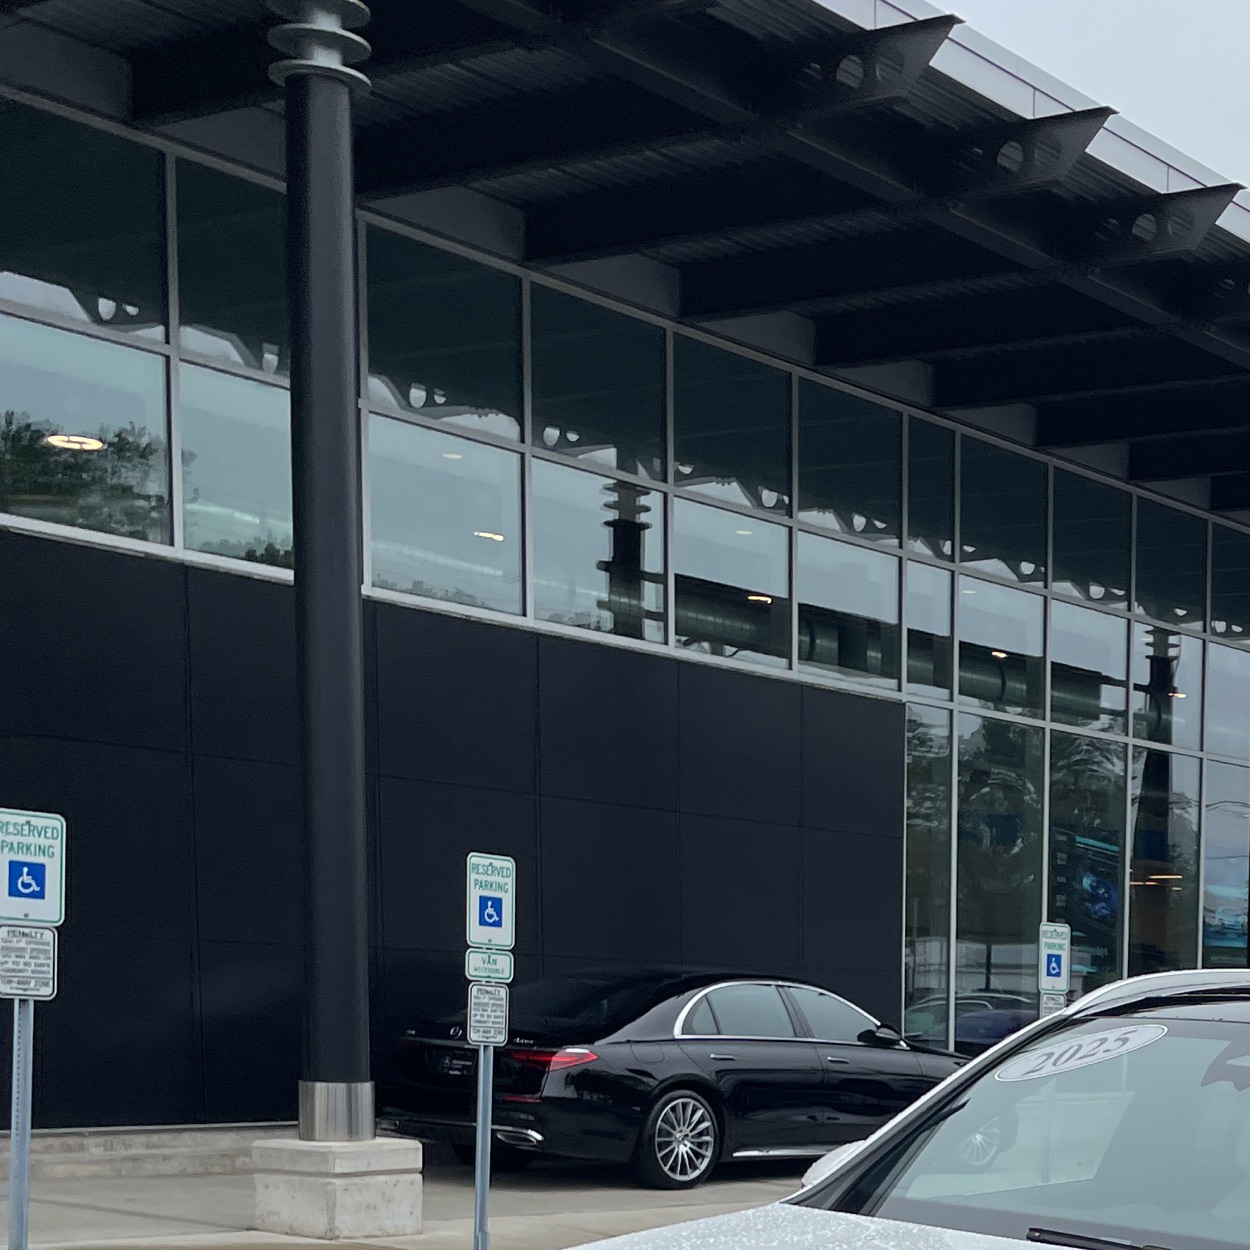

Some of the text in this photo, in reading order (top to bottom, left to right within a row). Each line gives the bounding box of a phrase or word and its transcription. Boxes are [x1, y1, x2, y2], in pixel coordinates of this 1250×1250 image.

[0, 820, 60, 840] RESERVED
[0, 840, 55, 859] PARKING
[471, 862, 512, 879] RESERVED
[474, 878, 509, 894] PARKING
[481, 956, 498, 966] VAN
[1021, 1029, 1138, 1077] 2025
